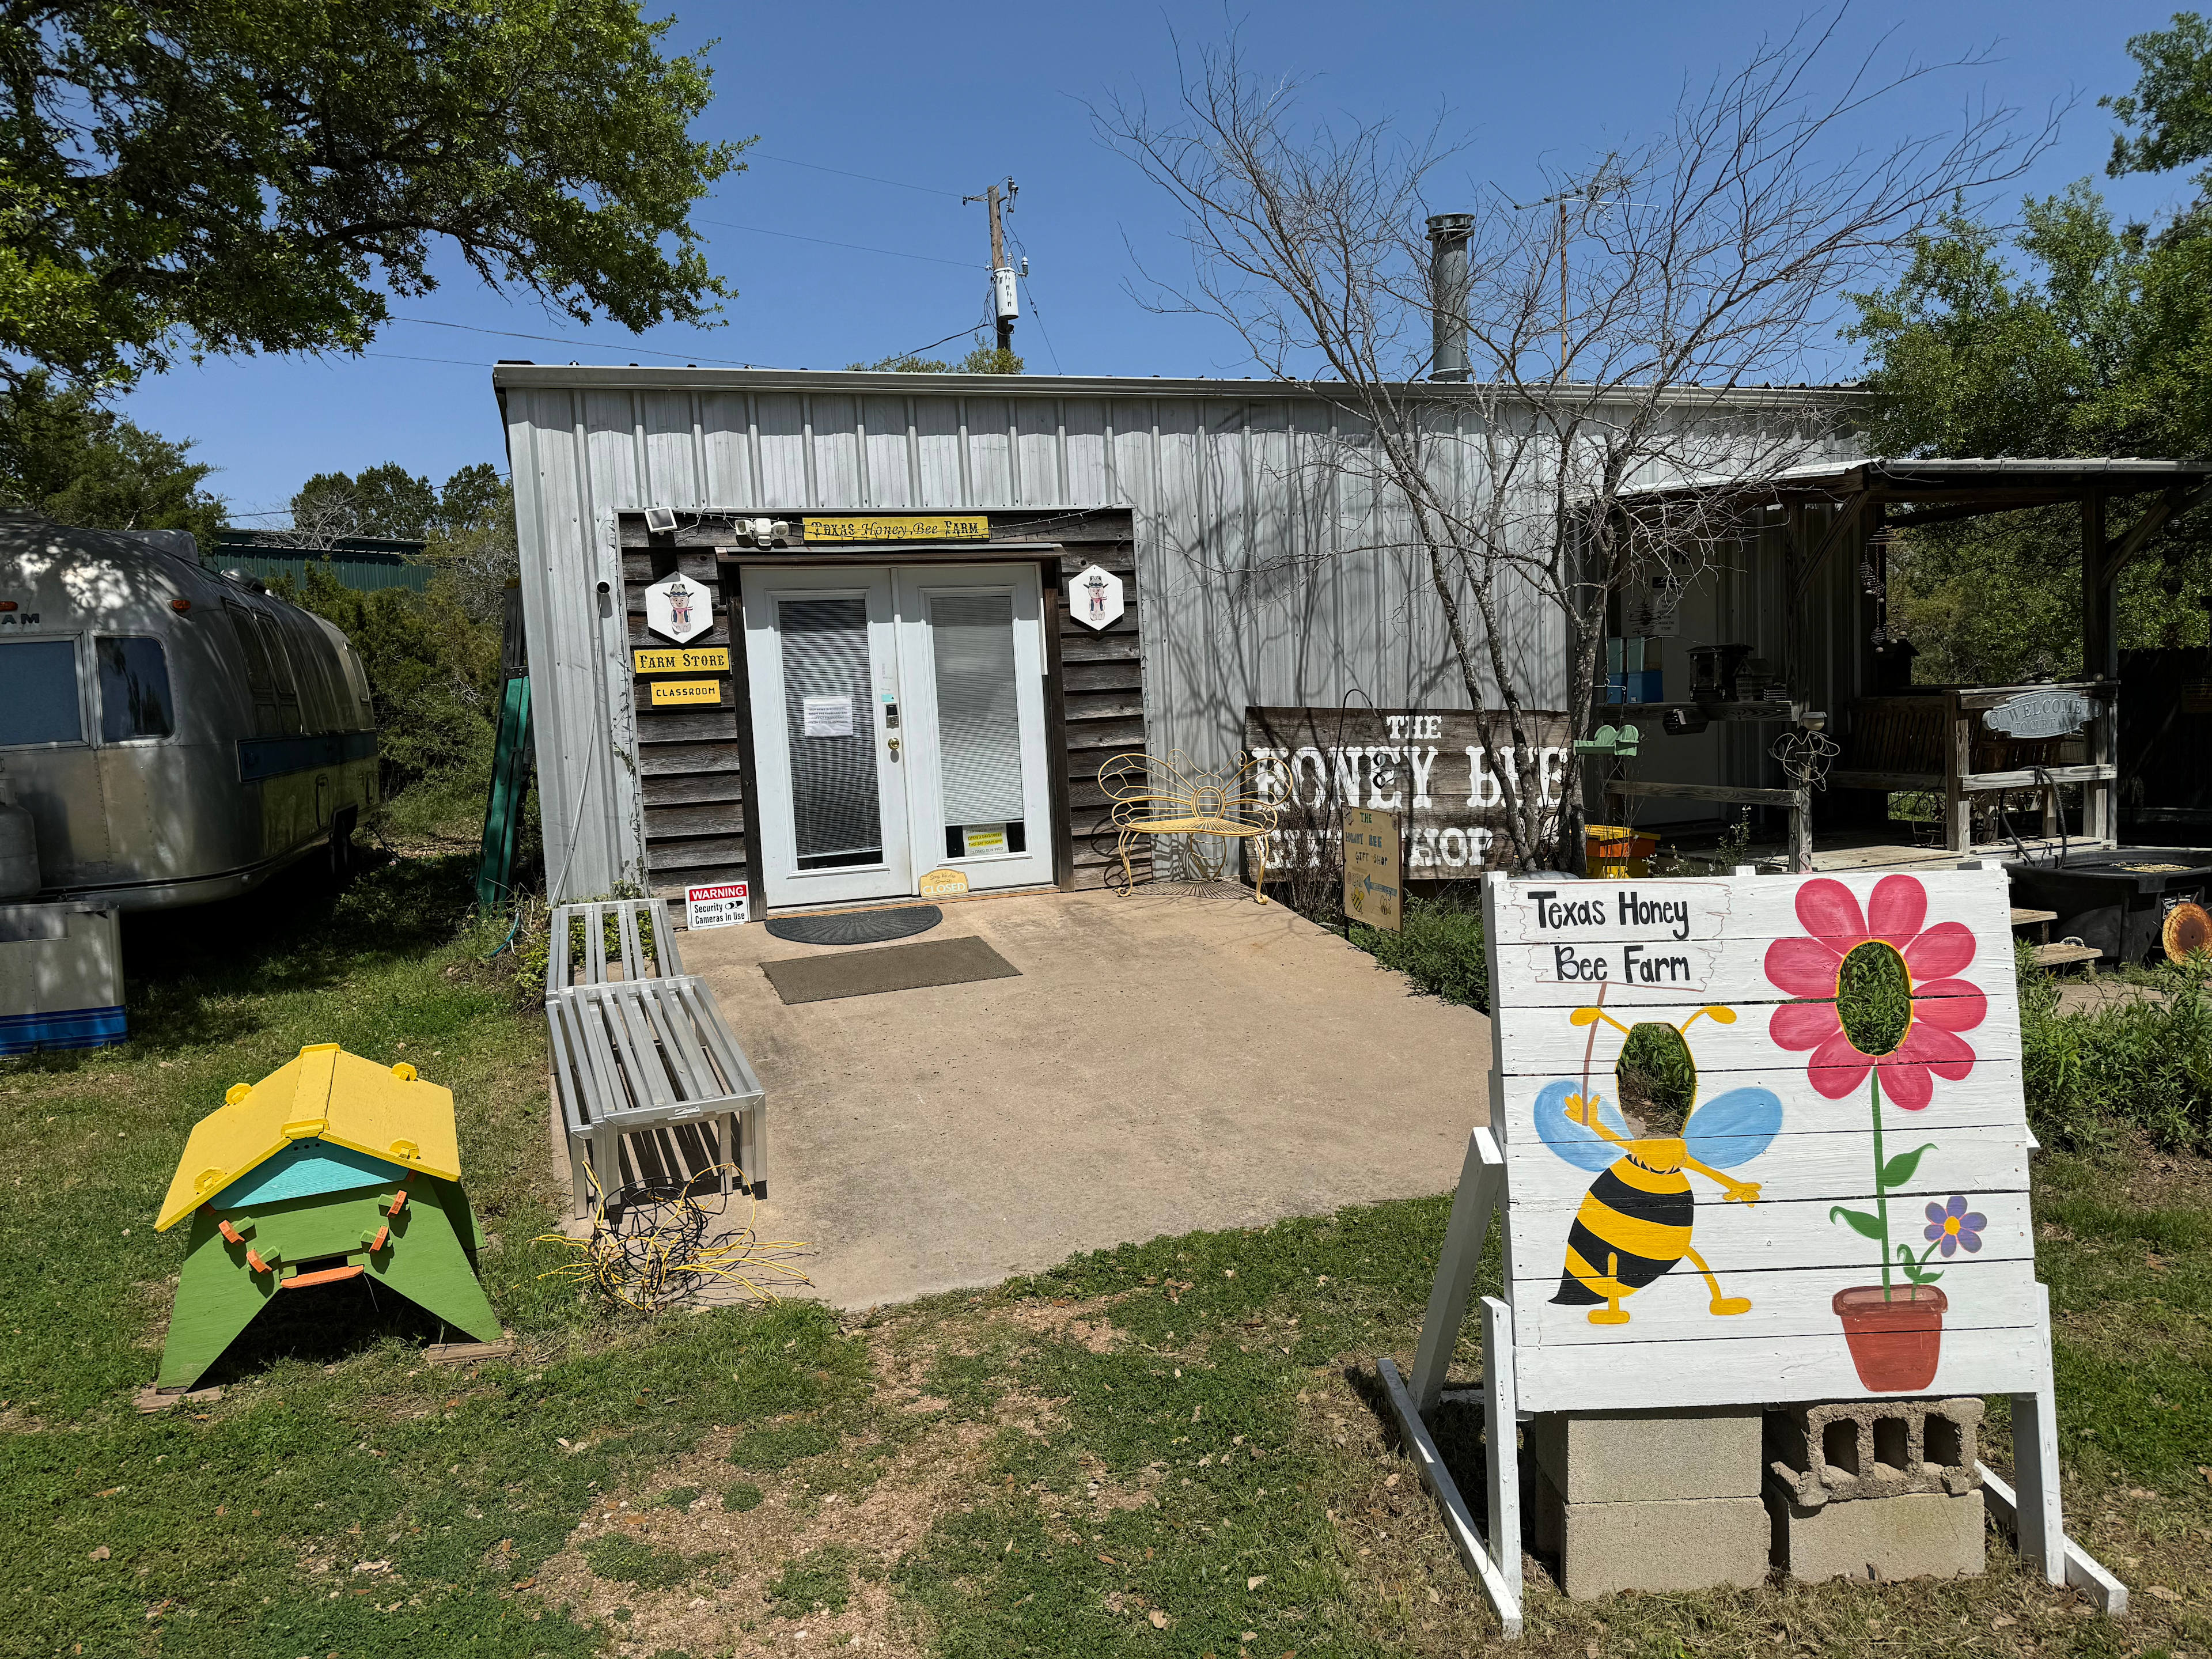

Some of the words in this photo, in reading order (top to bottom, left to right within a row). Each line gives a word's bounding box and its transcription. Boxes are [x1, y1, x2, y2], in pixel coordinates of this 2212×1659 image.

[862, 522, 907, 539] Honey
[913, 522, 938, 535] Bee
[944, 521, 979, 535] FARM
[639, 655, 676, 668] FARM
[683, 653, 725, 666] STORE
[656, 687, 715, 696] CLASSROOM
[2008, 699, 2082, 721] WELCOME
[1386, 715, 1442, 739] THE
[2015, 721, 2027, 732] TO
[2029, 719, 2048, 730] OUR
[2050, 716, 2077, 728] FARM
[1251, 745, 1438, 812] HONEY
[1359, 812, 1372, 824] THE
[1369, 834, 1382, 848] BEE
[1402, 827, 1493, 867] HOP
[1355, 851, 1369, 863] GIFT
[1373, 854, 1388, 866] SHOP
[692, 887, 744, 900] WARNING
[923, 882, 965, 895] CLOSED
[695, 903, 722, 913] Security
[1528, 891, 1605, 929] Texas
[1619, 892, 1689, 940] Honey
[695, 915, 724, 924] Cameras
[725, 912, 732, 921] In
[733, 912, 745, 920] Use
[1554, 945, 1608, 981] Bee
[1624, 945, 1690, 983] Farm
